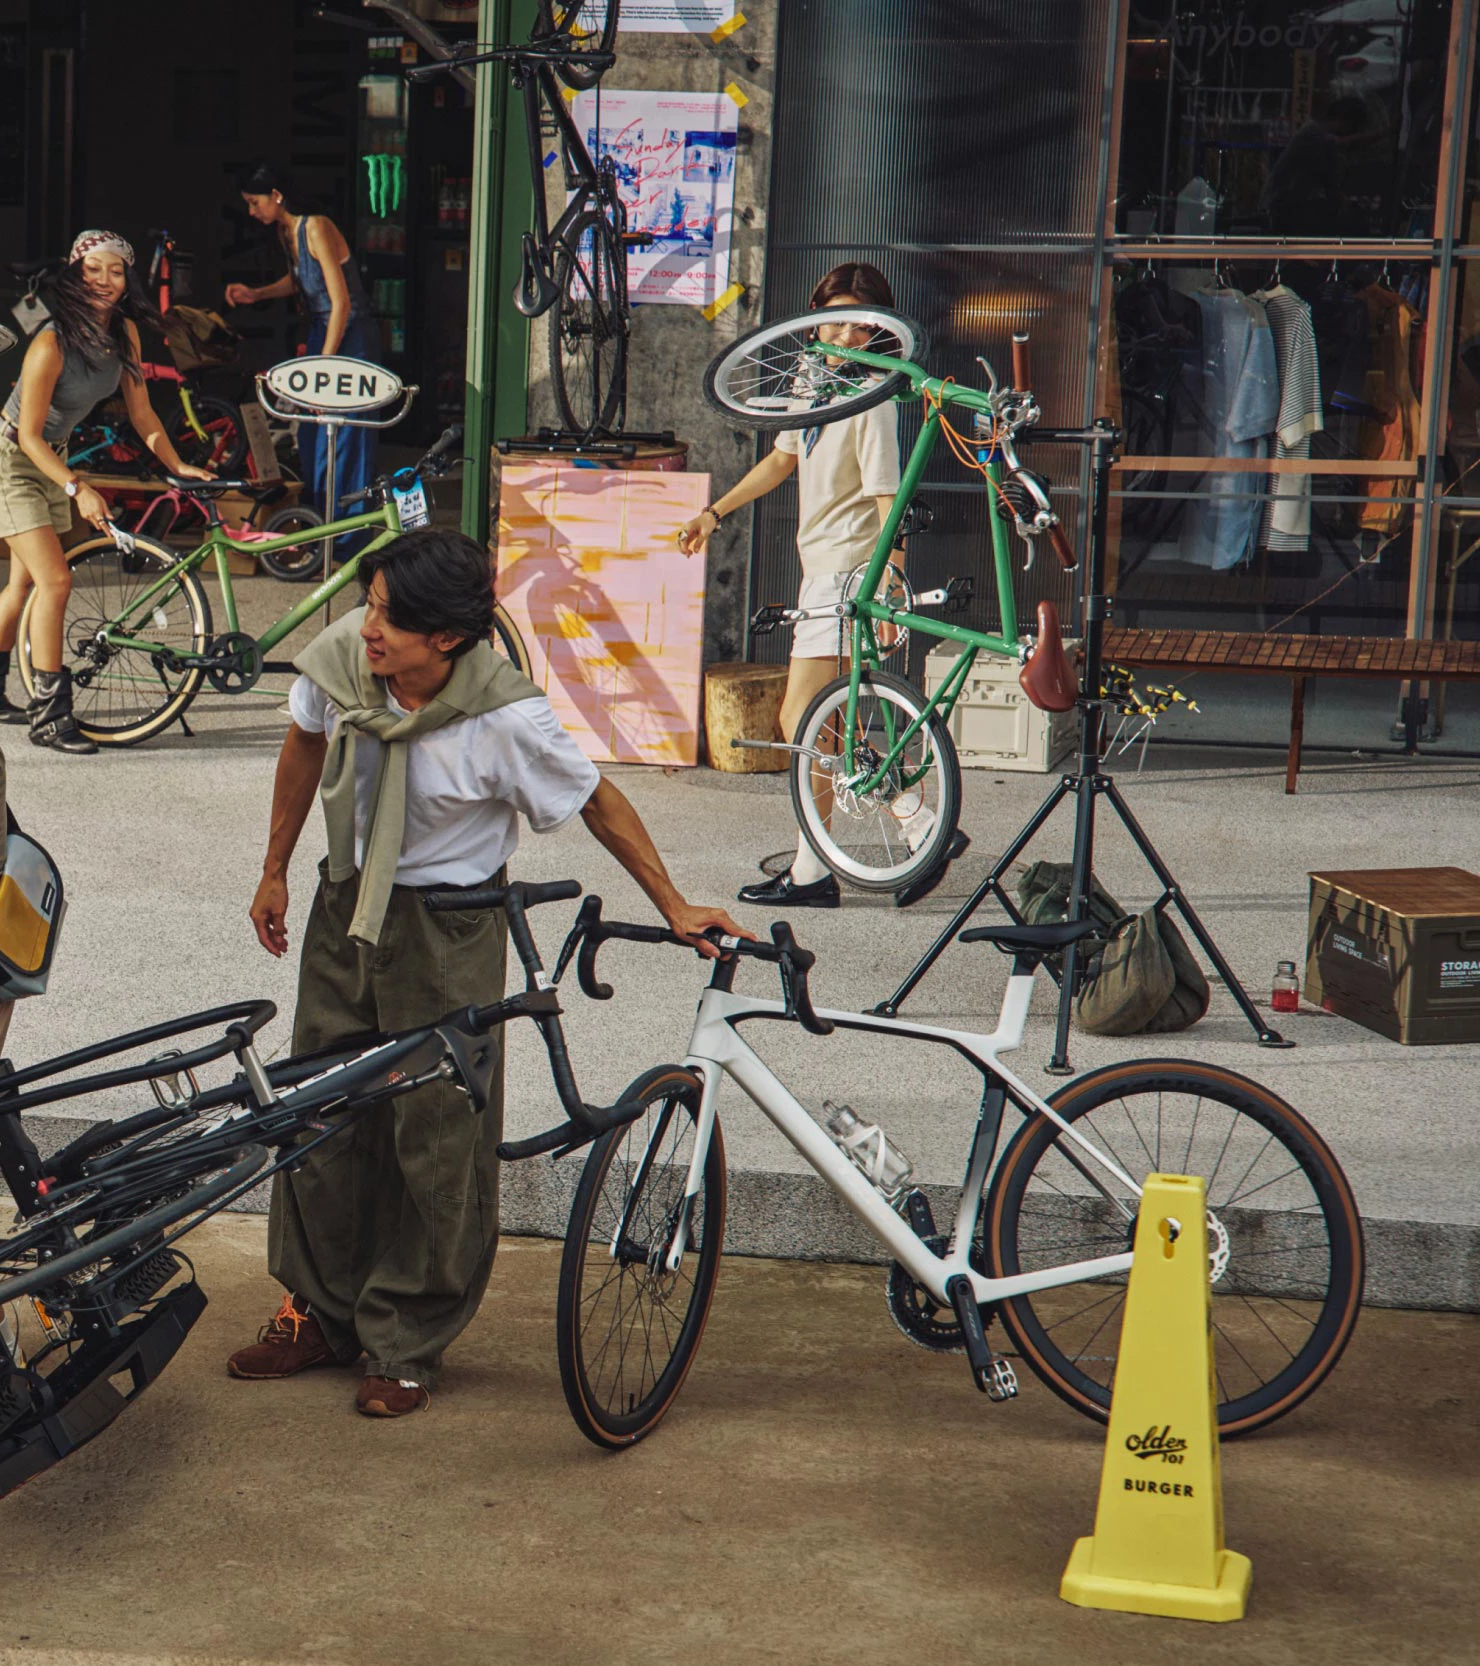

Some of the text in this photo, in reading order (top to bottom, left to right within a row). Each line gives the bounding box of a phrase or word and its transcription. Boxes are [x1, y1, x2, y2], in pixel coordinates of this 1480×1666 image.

[288, 370, 377, 397] OPEN
[1440, 960, 1480, 971] STORA
[1123, 1478, 1195, 1498] BURGER
